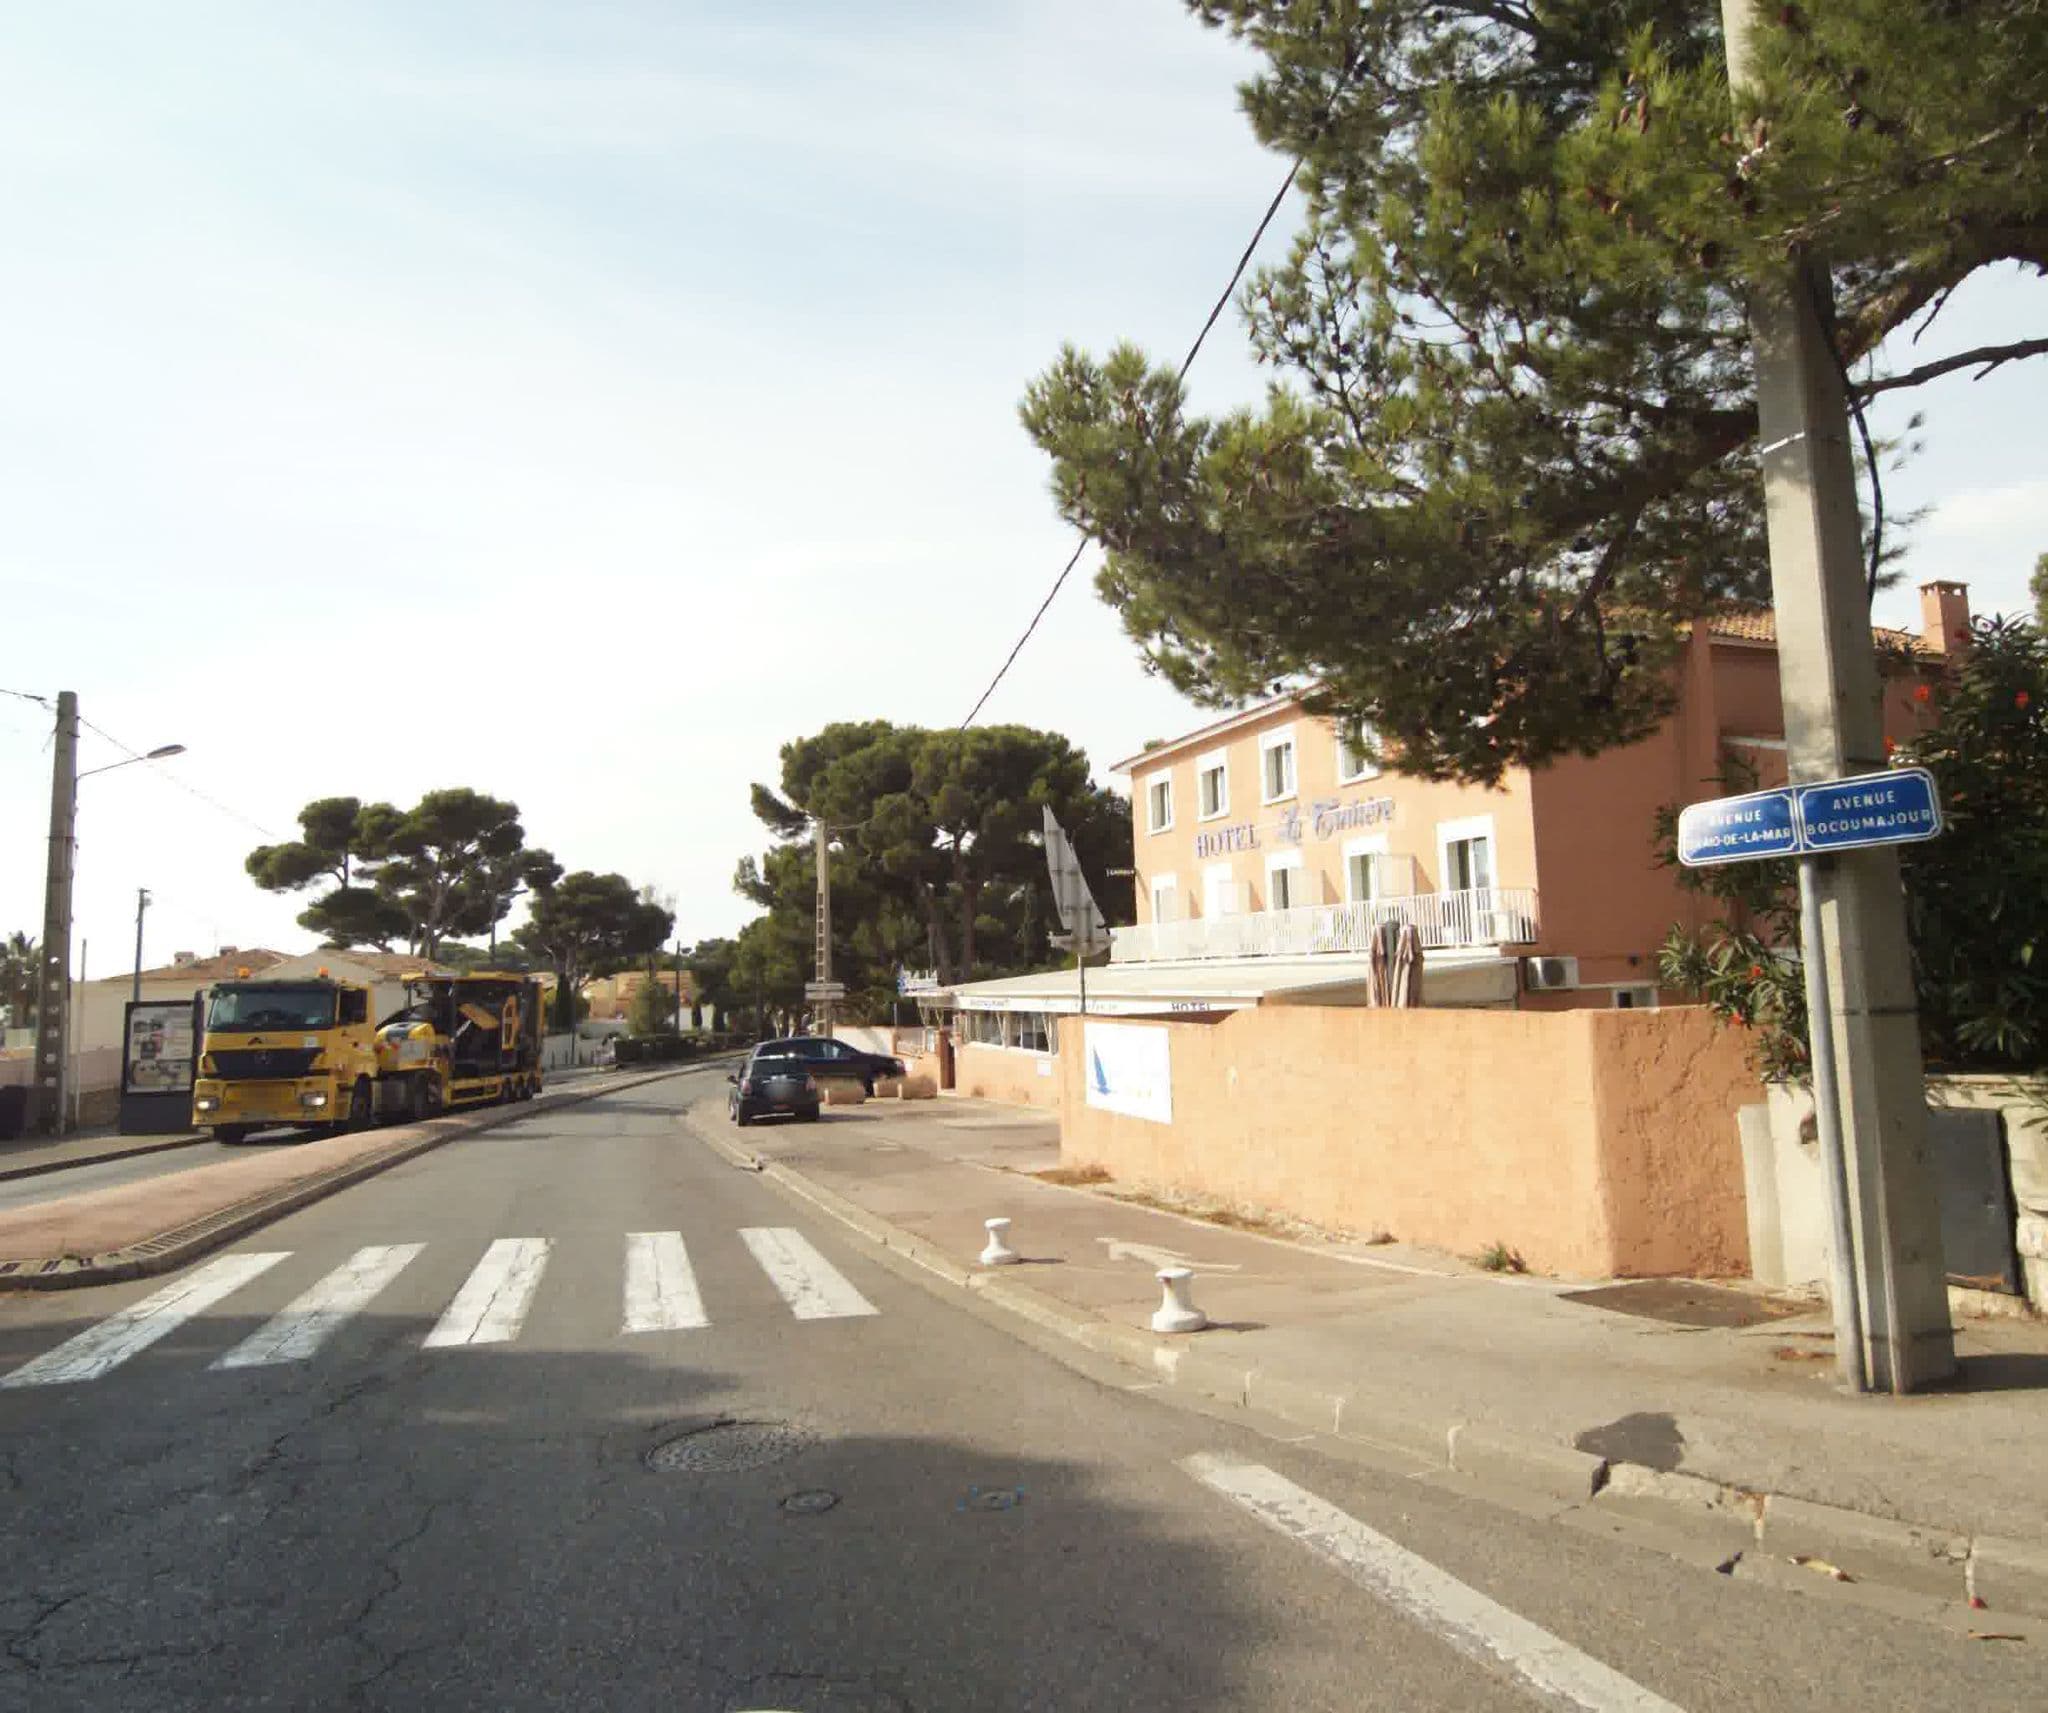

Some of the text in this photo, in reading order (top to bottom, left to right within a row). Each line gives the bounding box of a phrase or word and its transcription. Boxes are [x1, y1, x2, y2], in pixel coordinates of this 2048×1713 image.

[1833, 790, 1896, 811] AVENUE
[1807, 809, 1931, 835] BOCOUMAJOUR
[1171, 1002, 1210, 1012] HOTEL
